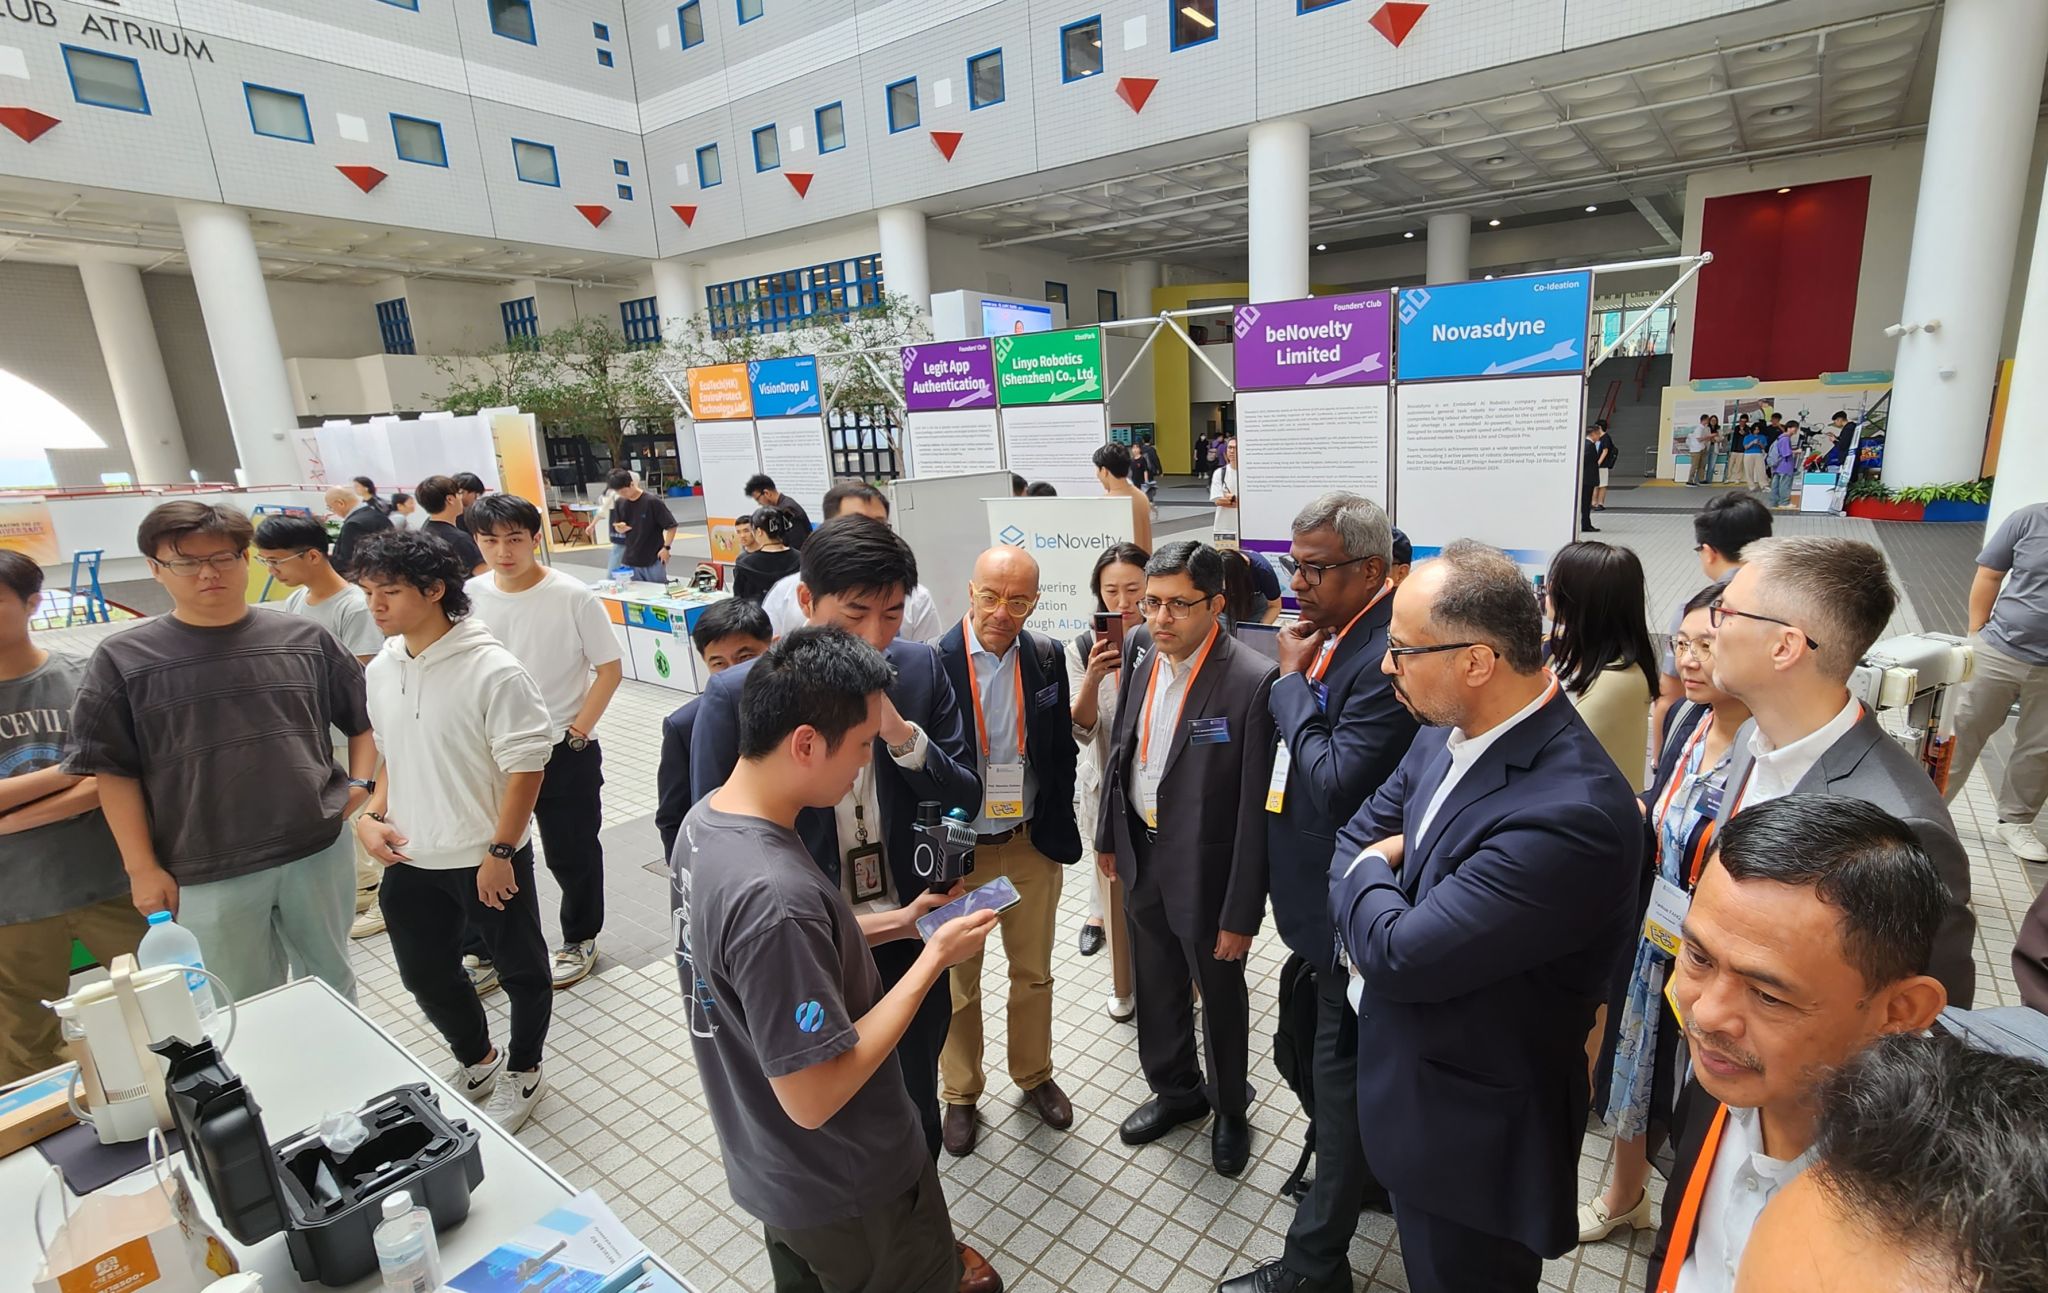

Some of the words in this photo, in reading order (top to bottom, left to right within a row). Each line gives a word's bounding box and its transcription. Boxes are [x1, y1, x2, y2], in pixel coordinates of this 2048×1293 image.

[0, 0, 57, 27] UB
[81, 14, 214, 63] ATRIUM
[1533, 280, 1580, 292] Co-Ideation
[1333, 301, 1365, 311] Founders'
[1366, 300, 1382, 308] Club
[1265, 320, 1352, 343] beNovelty
[1432, 318, 1546, 342] Novasdyne
[1012, 356, 1039, 371] Linyo
[1039, 352, 1083, 368] Robotics
[1276, 344, 1341, 366] Limited
[923, 360, 949, 378] Legit
[949, 359, 970, 376] App
[758, 382, 800, 396] VisionDrop
[800, 380, 809, 392] AI
[912, 376, 986, 394] Authentication
[1001, 370, 1055, 388] (Shenzhen)
[1056, 370, 1076, 384] Co.,
[1035, 532, 1122, 550] beNovelty
[1039, 582, 1077, 596] wering
[1038, 600, 1068, 611] ation
[1026, 618, 1055, 632] ough
[1058, 618, 1089, 630] AI-Dr
